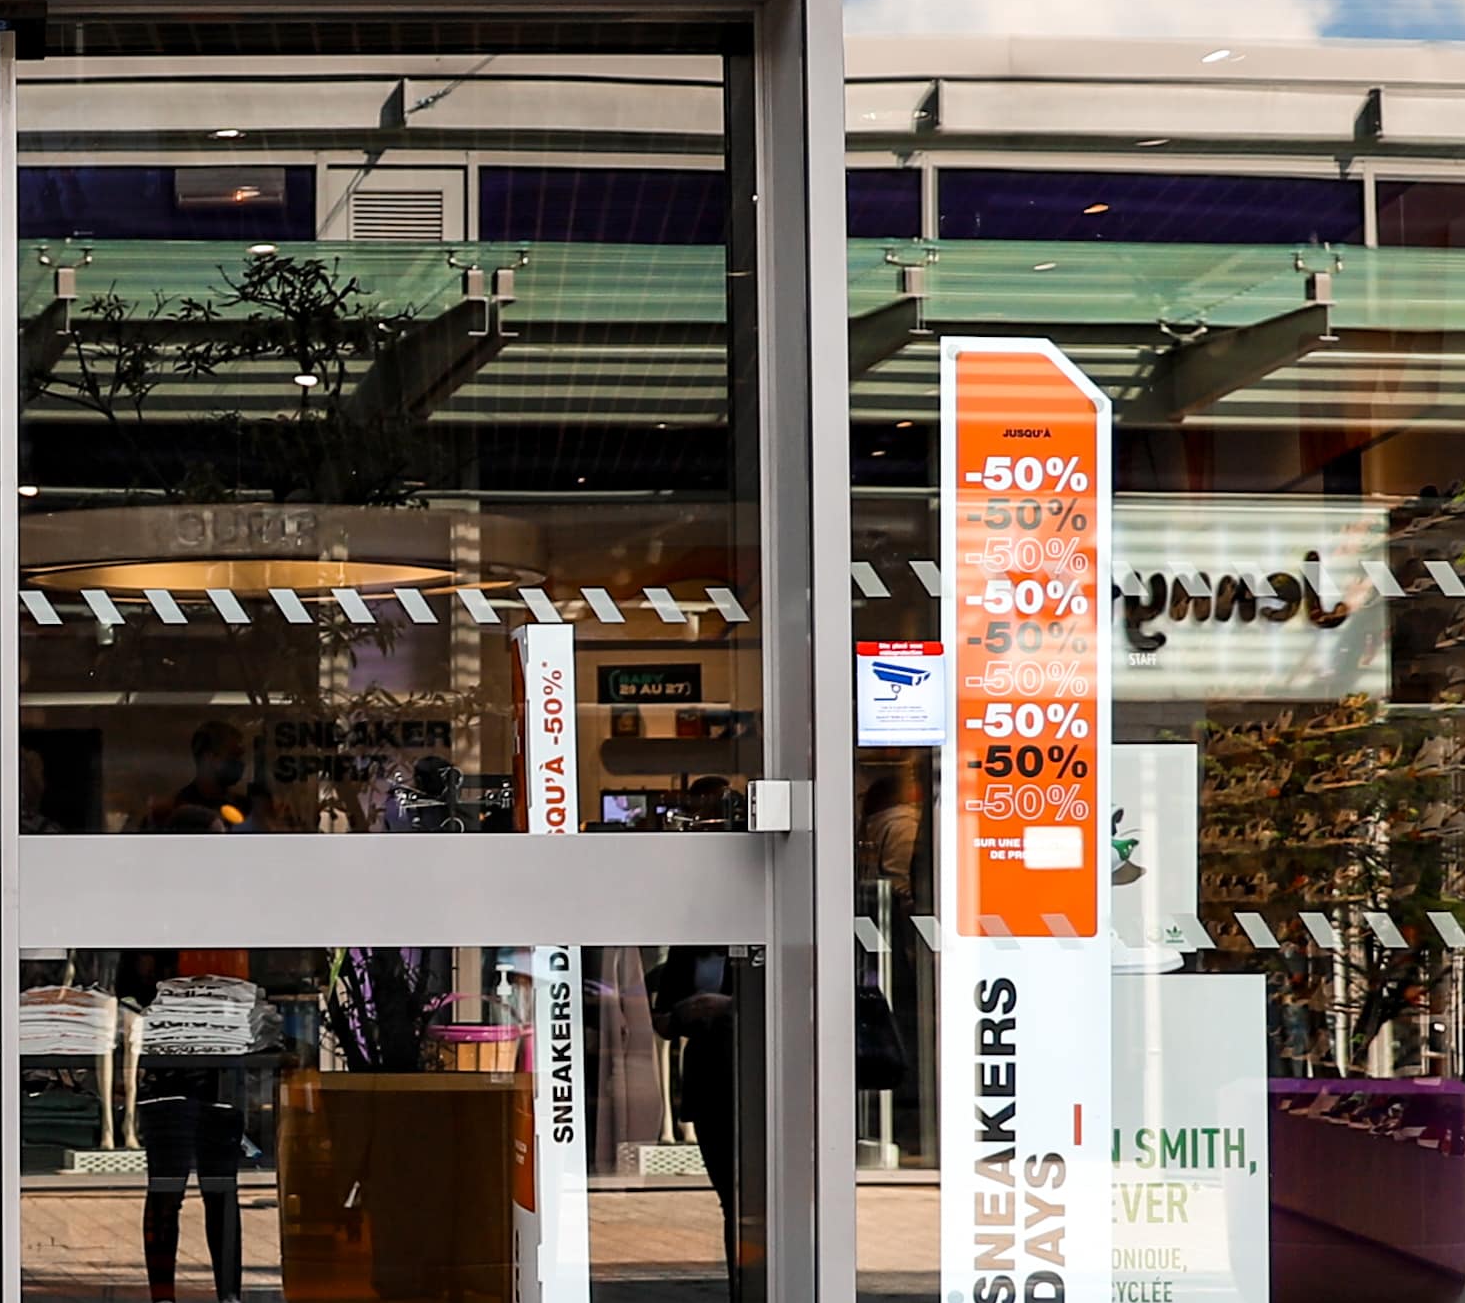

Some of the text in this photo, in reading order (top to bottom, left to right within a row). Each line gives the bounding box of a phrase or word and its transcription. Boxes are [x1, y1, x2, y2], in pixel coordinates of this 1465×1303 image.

[1002, 427, 1052, 440] JUSQU'À
[965, 456, 1088, 492] -50%
[965, 498, 1088, 531] -50%
[965, 537, 1088, 574] -50%
[965, 580, 1088, 615] -50%
[965, 622, 1088, 654] -50%
[1129, 653, 1157, 666] STAFF
[640, 684, 662, 694] AU
[965, 660, 1088, 697] -50%
[965, 703, 1088, 738] -50%
[965, 745, 1088, 779] -50%
[965, 784, 1088, 821] -50%
[972, 838, 1020, 847] SUR UNE
[990, 850, 1006, 860] DE
[549, 981, 574, 1143] SNEAKERS
[1135, 1127, 1257, 1176] SMITH,
[1111, 1276, 1173, 1303] YCLÉE
